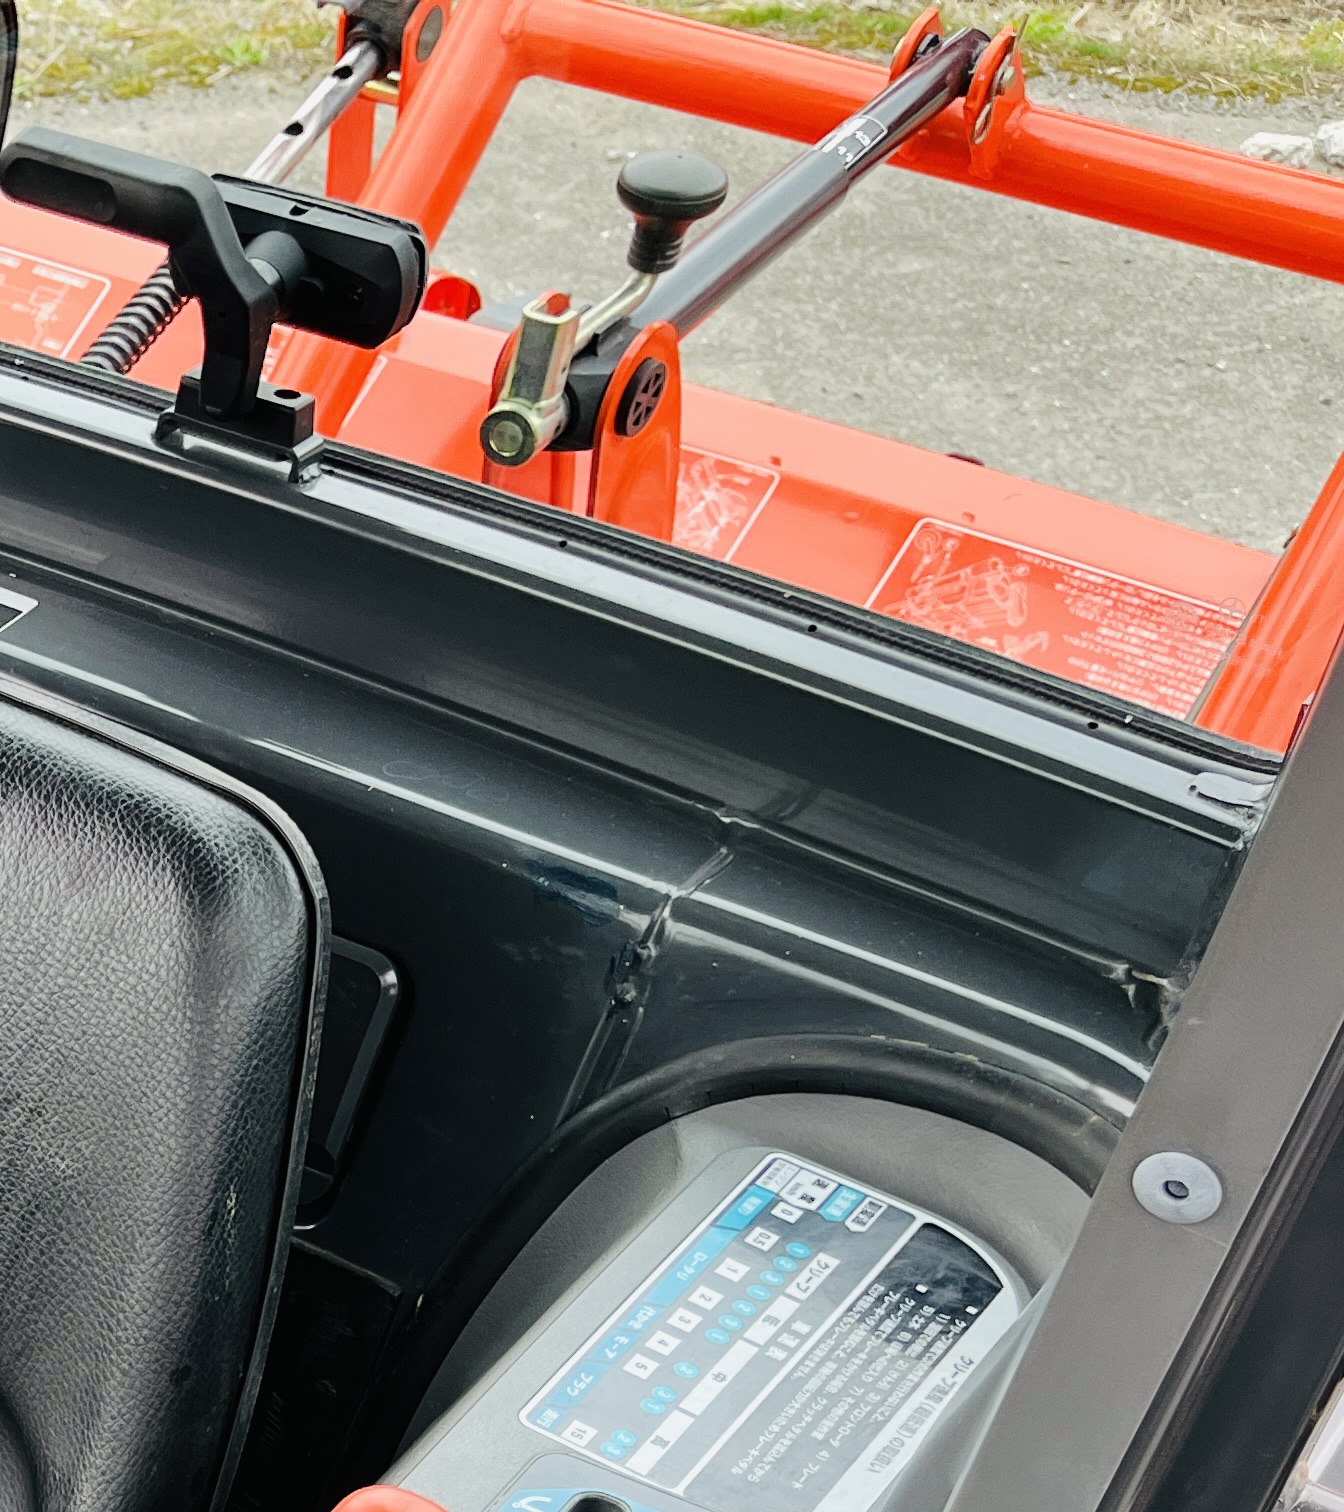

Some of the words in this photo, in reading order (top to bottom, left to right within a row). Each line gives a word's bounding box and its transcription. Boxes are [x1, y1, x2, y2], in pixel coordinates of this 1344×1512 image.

[779, 1207, 794, 1217] 0
[724, 1264, 739, 1274] 1
[793, 1257, 829, 1294] クリープ
[697, 1293, 712, 1303] 2
[676, 1315, 692, 1325] 3
[655, 1338, 670, 1348] 4
[633, 1361, 648, 1371] 5
[709, 1367, 728, 1386] 中
[569, 1425, 588, 1440] 15
